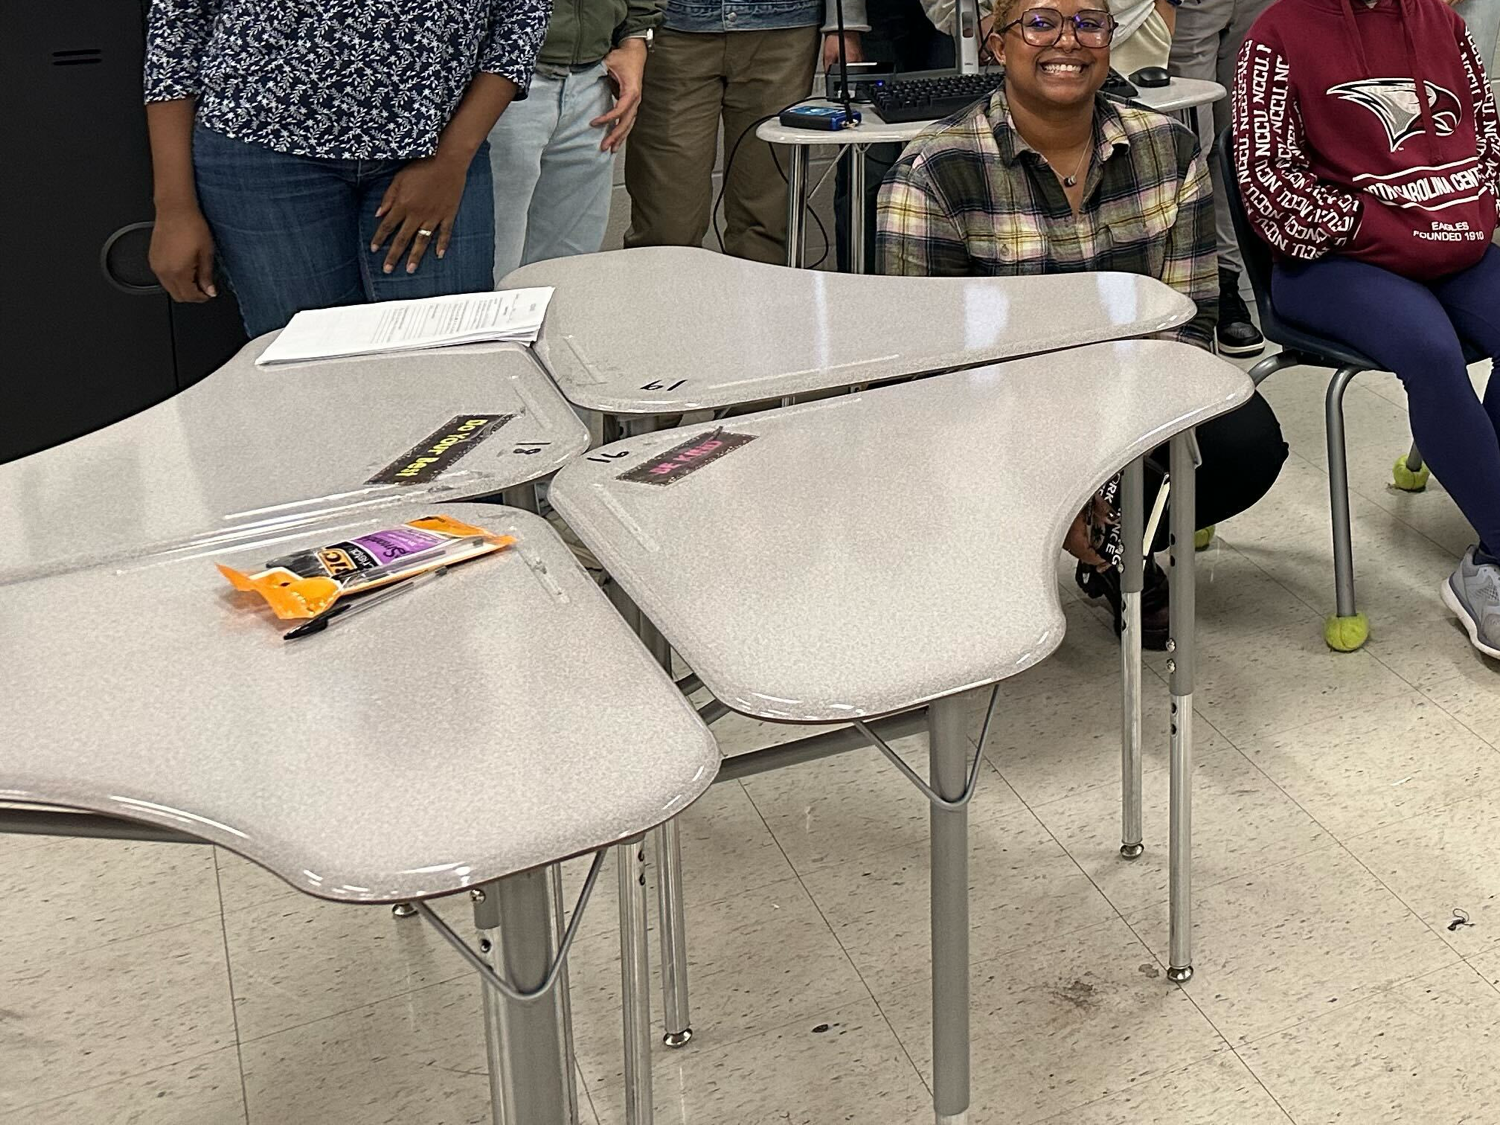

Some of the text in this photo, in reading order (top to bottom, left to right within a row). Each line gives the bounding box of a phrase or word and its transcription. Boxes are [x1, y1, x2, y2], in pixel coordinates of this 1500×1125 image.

[1252, 57, 1270, 105] NCCU.
[1253, 108, 1270, 157] NCCU.
[1270, 86, 1288, 135] NCCU.
[1413, 230, 1484, 242] FOUNDED 1910
[1431, 222, 1469, 230] EAGLES
[395, 420, 488, 476] Do Your Best
